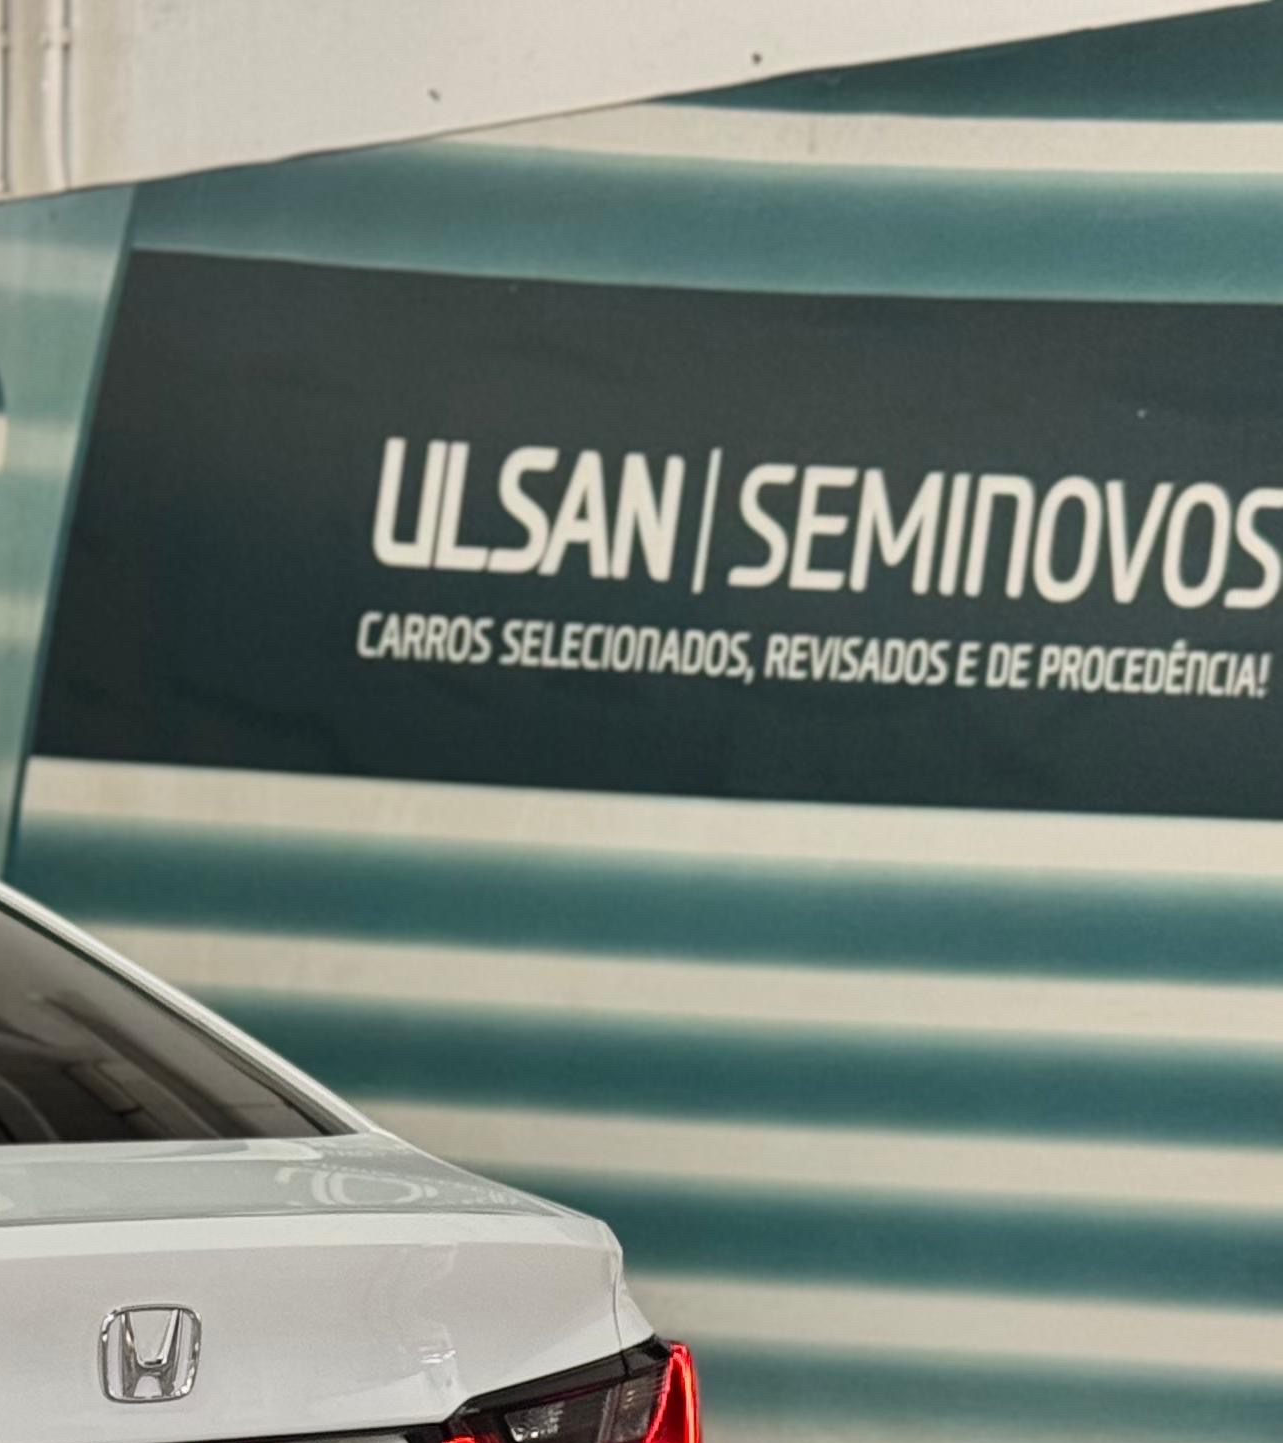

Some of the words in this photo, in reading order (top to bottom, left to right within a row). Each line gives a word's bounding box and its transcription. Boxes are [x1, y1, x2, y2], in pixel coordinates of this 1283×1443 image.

[372, 436, 686, 583] ULSAN
[727, 462, 1283, 610] SEMINOVOS
[356, 610, 495, 664] CARROS
[498, 618, 756, 685] SELECIONADOS,
[763, 632, 952, 687] REVISADOS
[954, 640, 982, 688] E
[984, 641, 1035, 690] DE
[1036, 638, 1273, 699] PROCEDÊNCIA!
